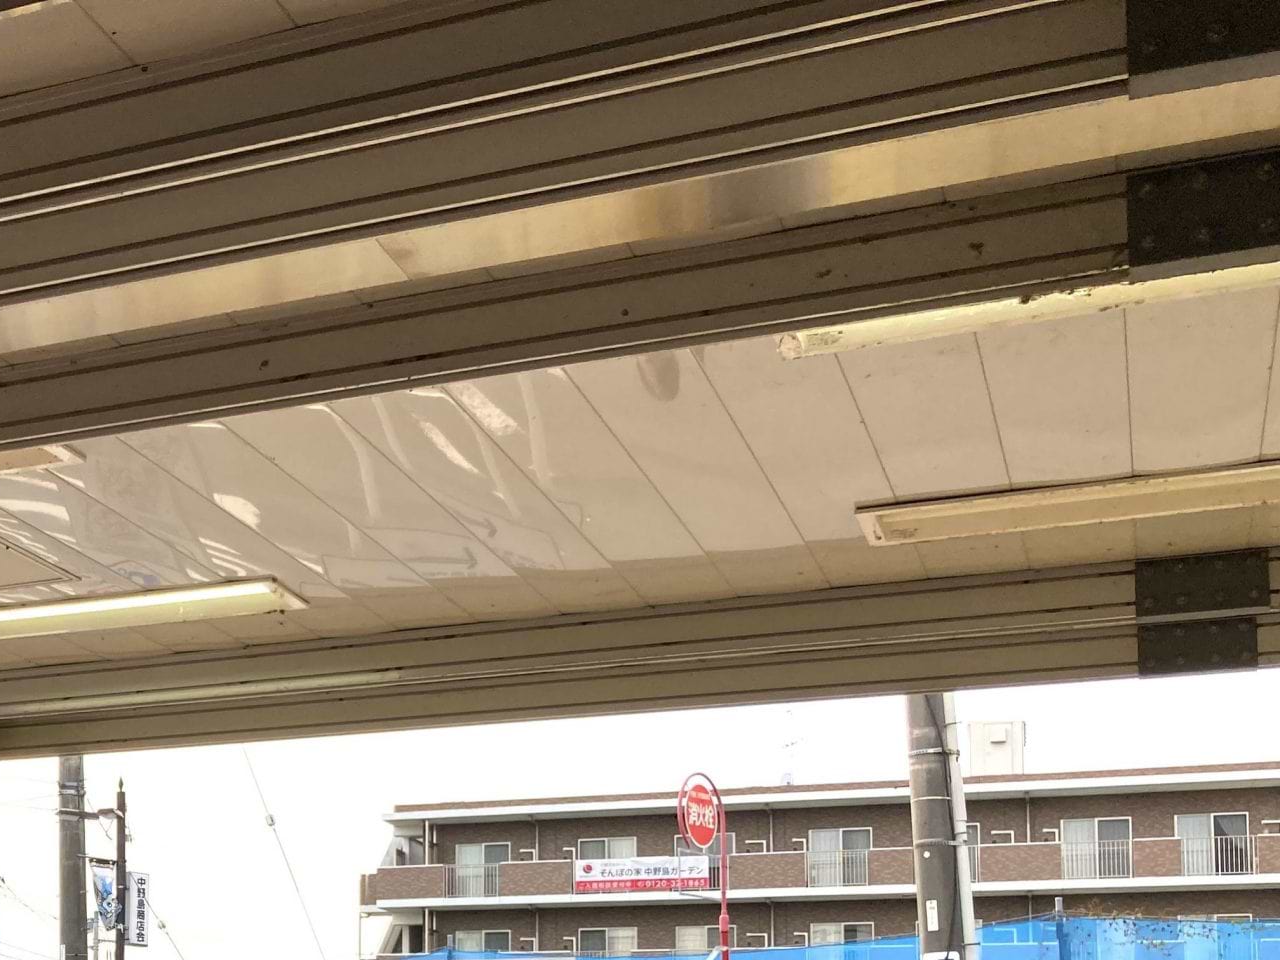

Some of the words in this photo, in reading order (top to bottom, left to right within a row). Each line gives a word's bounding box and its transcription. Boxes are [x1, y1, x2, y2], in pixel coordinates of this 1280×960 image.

[687, 801, 715, 829] 消火栓
[137, 877, 146, 942] 中野島商店会
